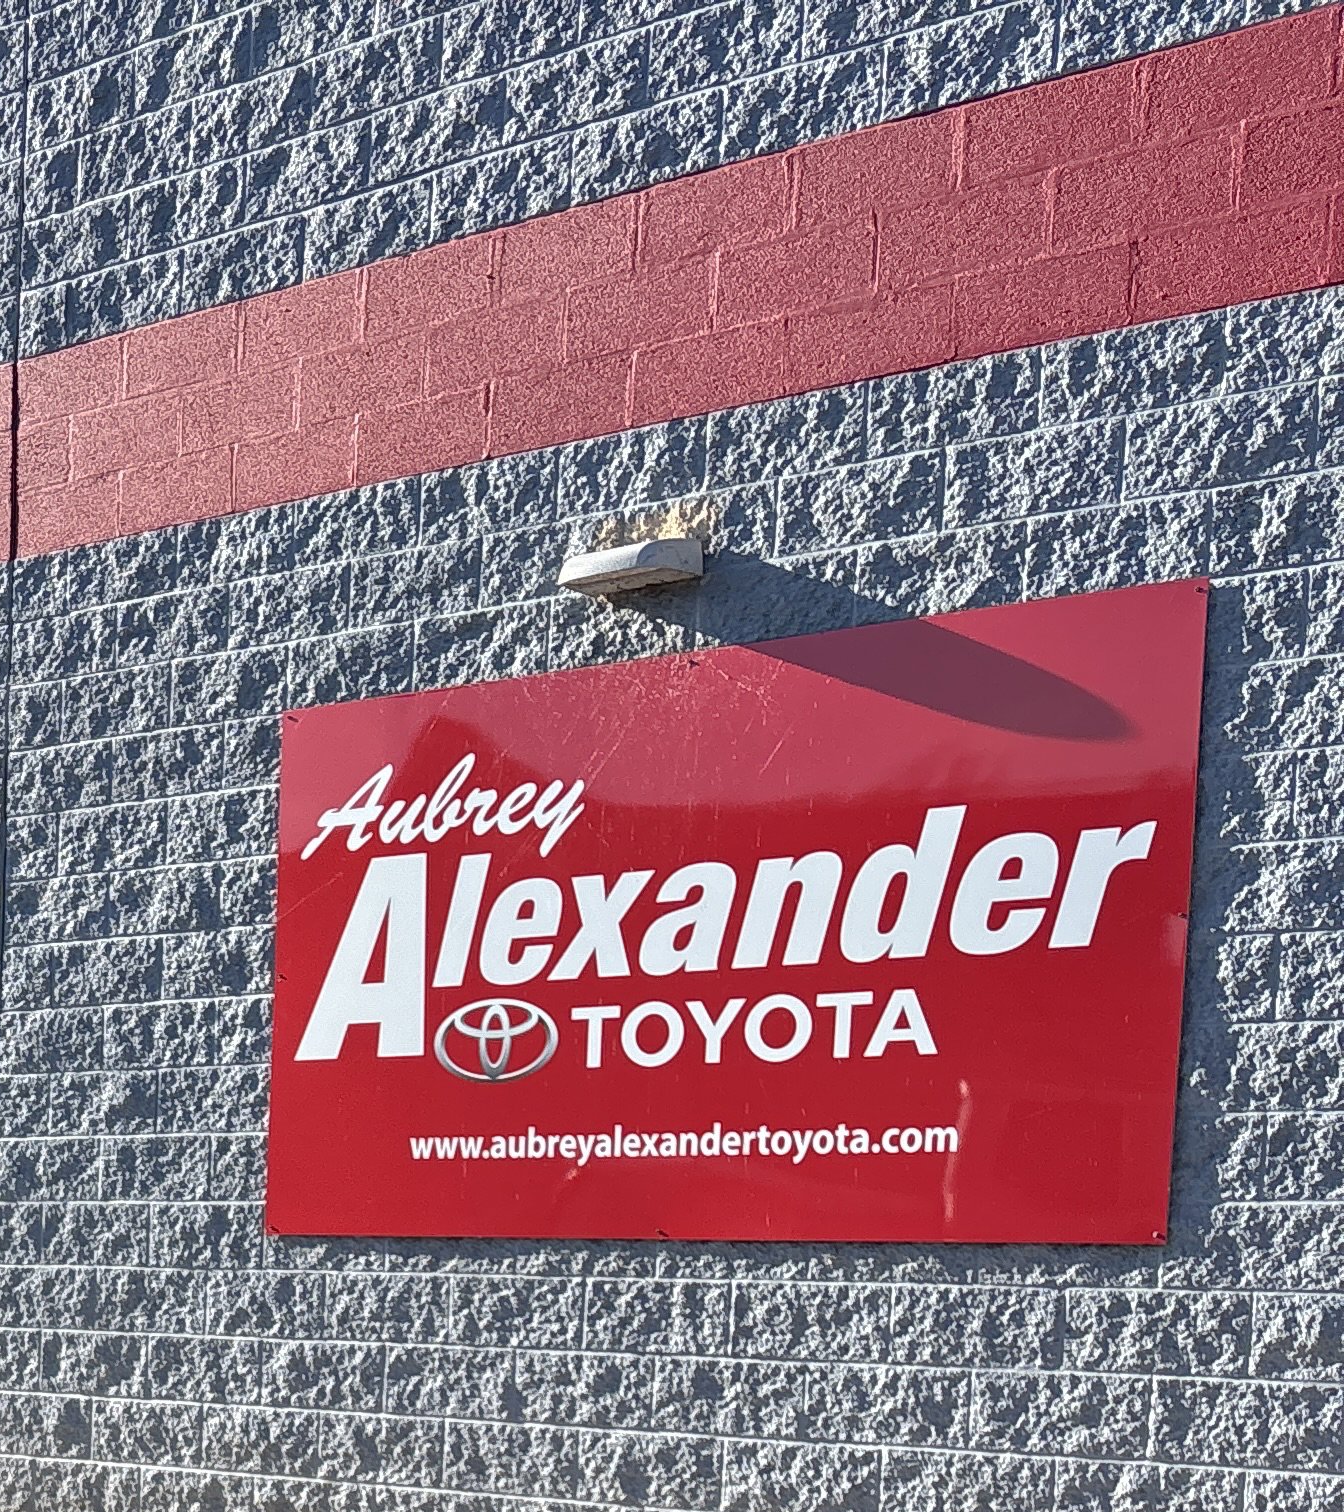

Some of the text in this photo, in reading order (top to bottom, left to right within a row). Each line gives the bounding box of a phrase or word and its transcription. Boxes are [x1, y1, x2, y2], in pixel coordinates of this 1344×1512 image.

[300, 752, 585, 861] Aubrey
[293, 804, 1158, 1062] Alexander
[570, 988, 938, 1069] TOYOTA
[409, 1122, 959, 1167] www.aubreyalexandertoyota.com
